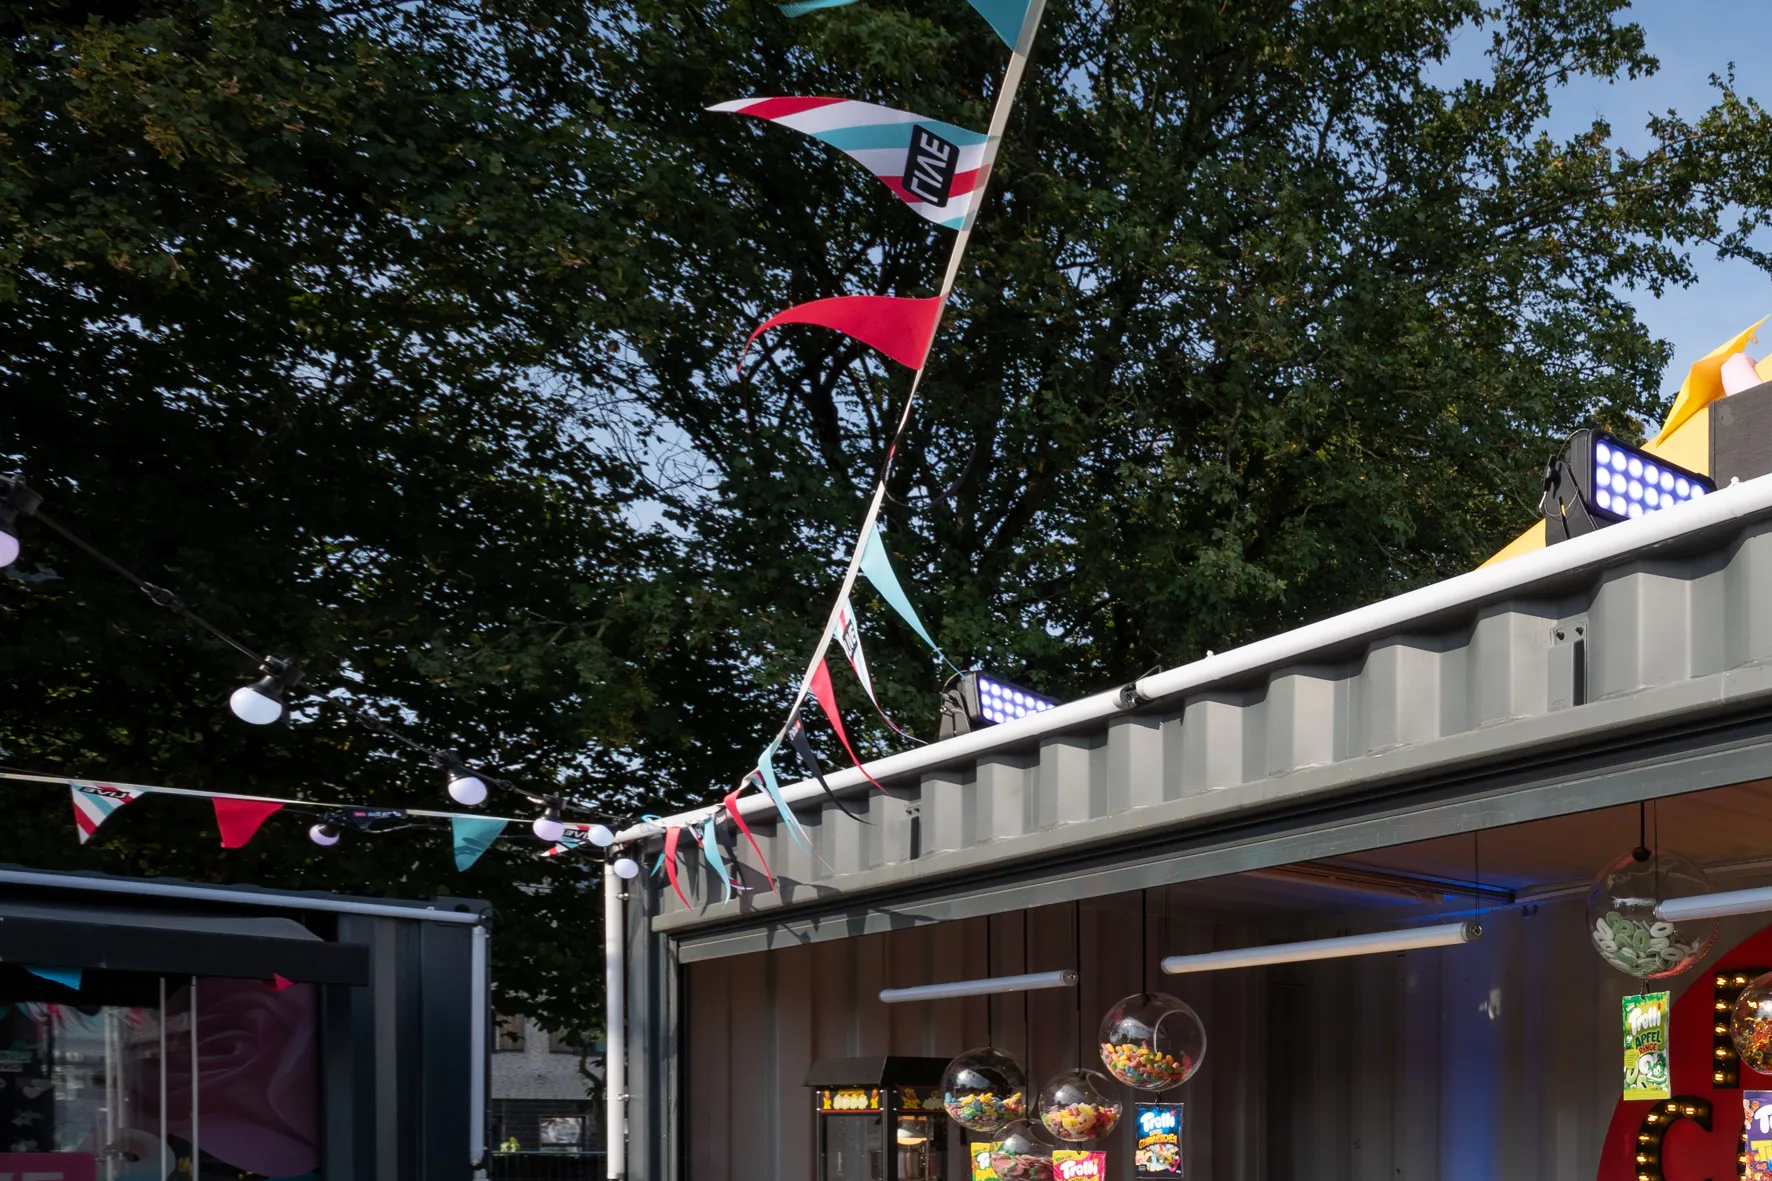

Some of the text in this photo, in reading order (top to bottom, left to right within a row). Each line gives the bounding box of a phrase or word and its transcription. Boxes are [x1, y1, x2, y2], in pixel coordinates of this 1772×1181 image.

[1629, 1002, 1662, 1036] Trolli
[1635, 1031, 1662, 1050] APFEL
[1639, 1043, 1658, 1055] RINGE
[1140, 1110, 1176, 1132] Trolli
[1060, 1158, 1098, 1179] Trolli
